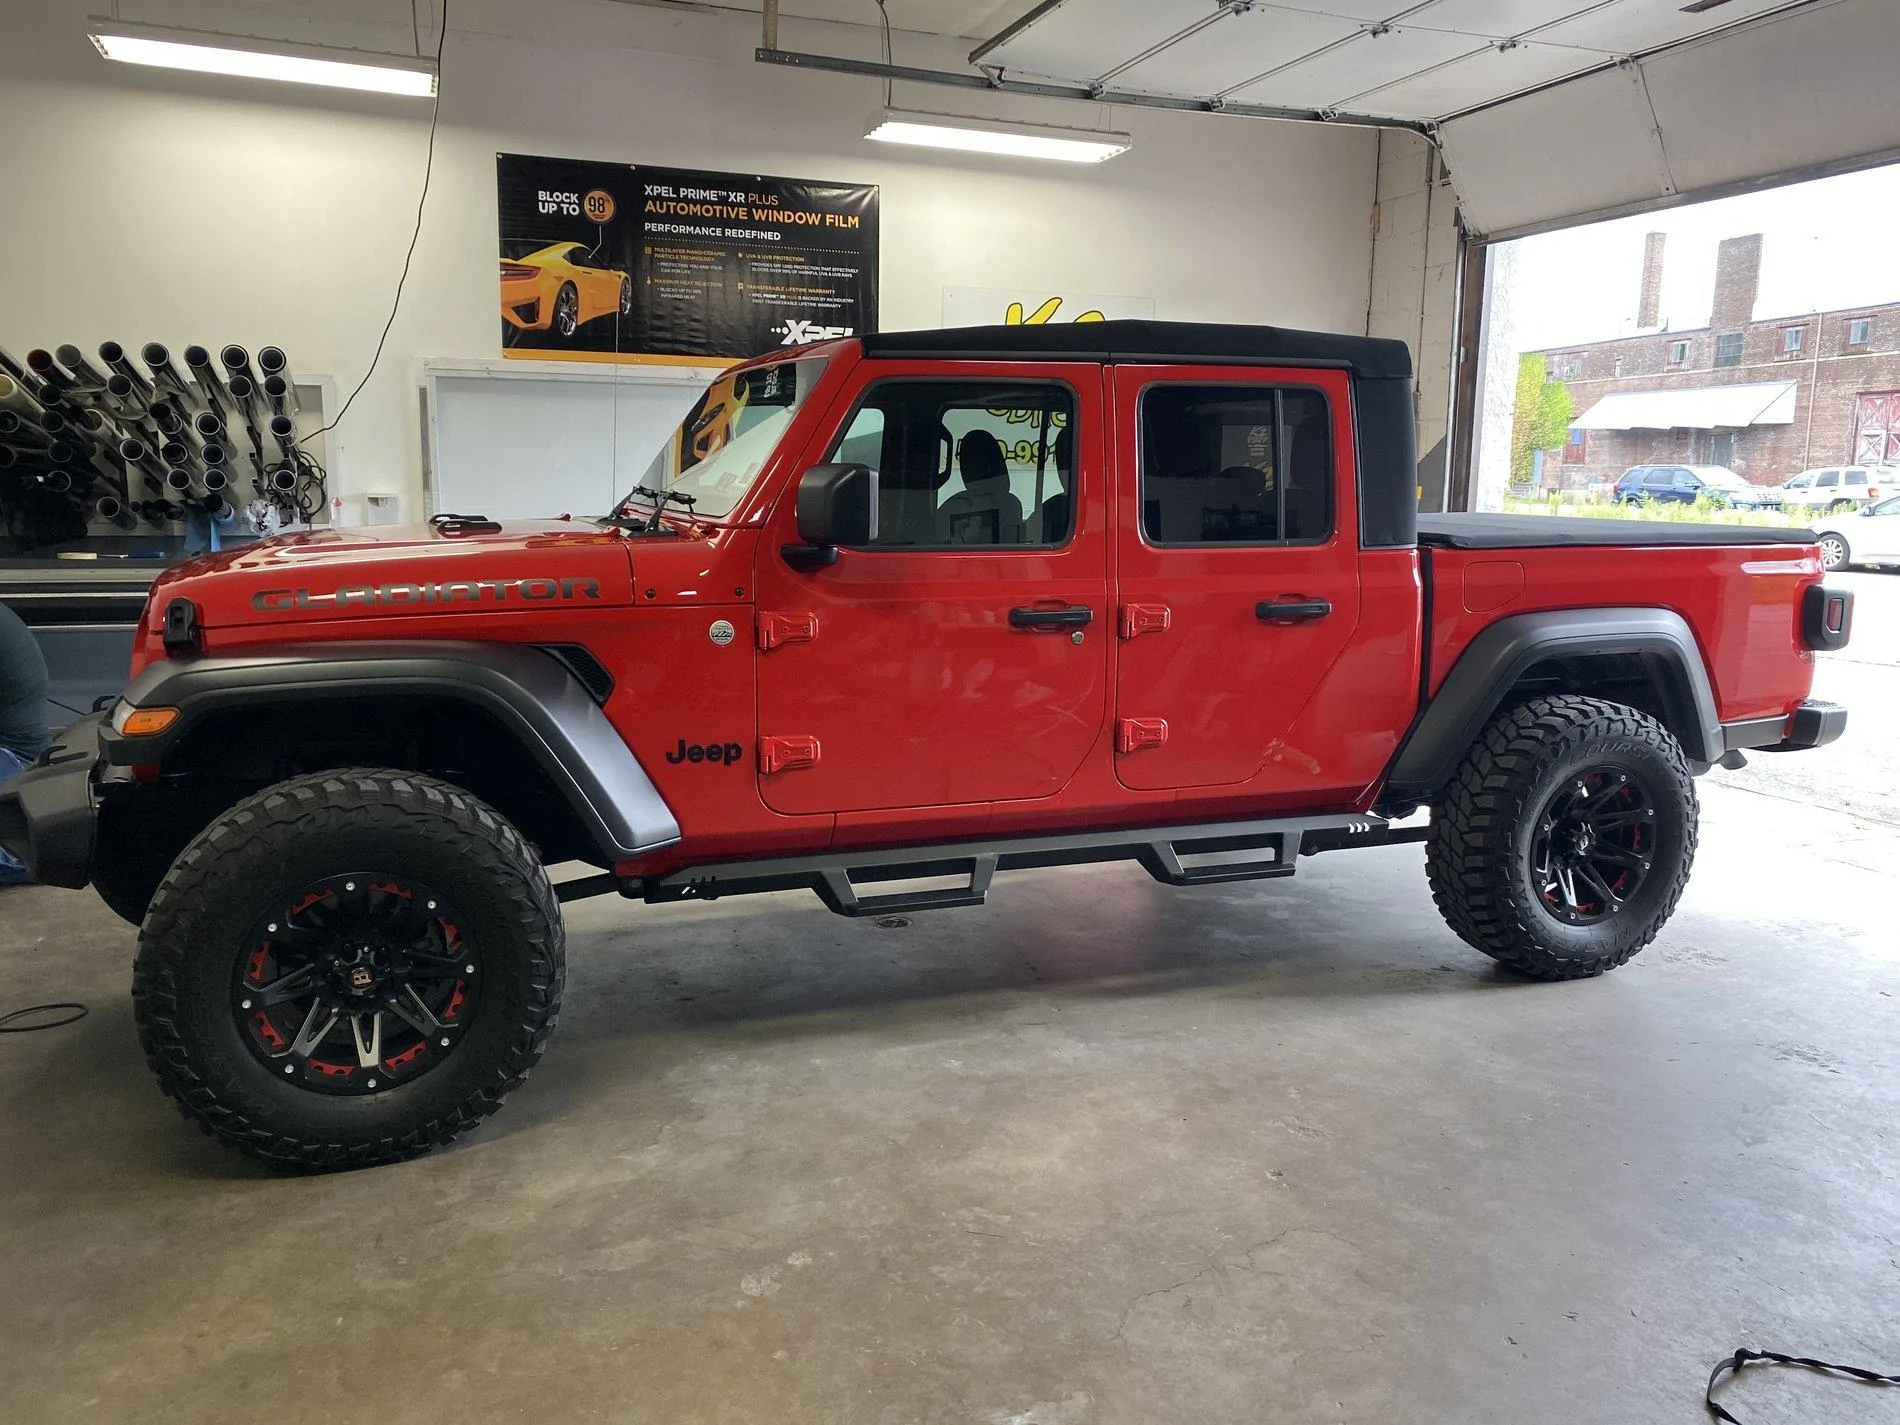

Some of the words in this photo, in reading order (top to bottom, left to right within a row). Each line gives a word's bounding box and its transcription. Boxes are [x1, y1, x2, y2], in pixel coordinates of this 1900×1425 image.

[538, 190, 579, 203] BLOCK
[644, 184, 676, 199] XPEL
[728, 192, 745, 203] XR
[748, 193, 779, 206] PLUS
[538, 202, 557, 214] UP
[560, 203, 580, 216] TO
[644, 200, 748, 220] AUTOMOTIVE
[752, 208, 821, 226] WINDOW
[826, 214, 859, 229] FILM
[644, 222, 722, 236] PERFORMANCE
[725, 229, 781, 241] REDEFINED
[746, 284, 785, 292] TRANSFERABLE
[252, 577, 601, 611] GLADIATOR
[666, 739, 743, 766] Jeep
